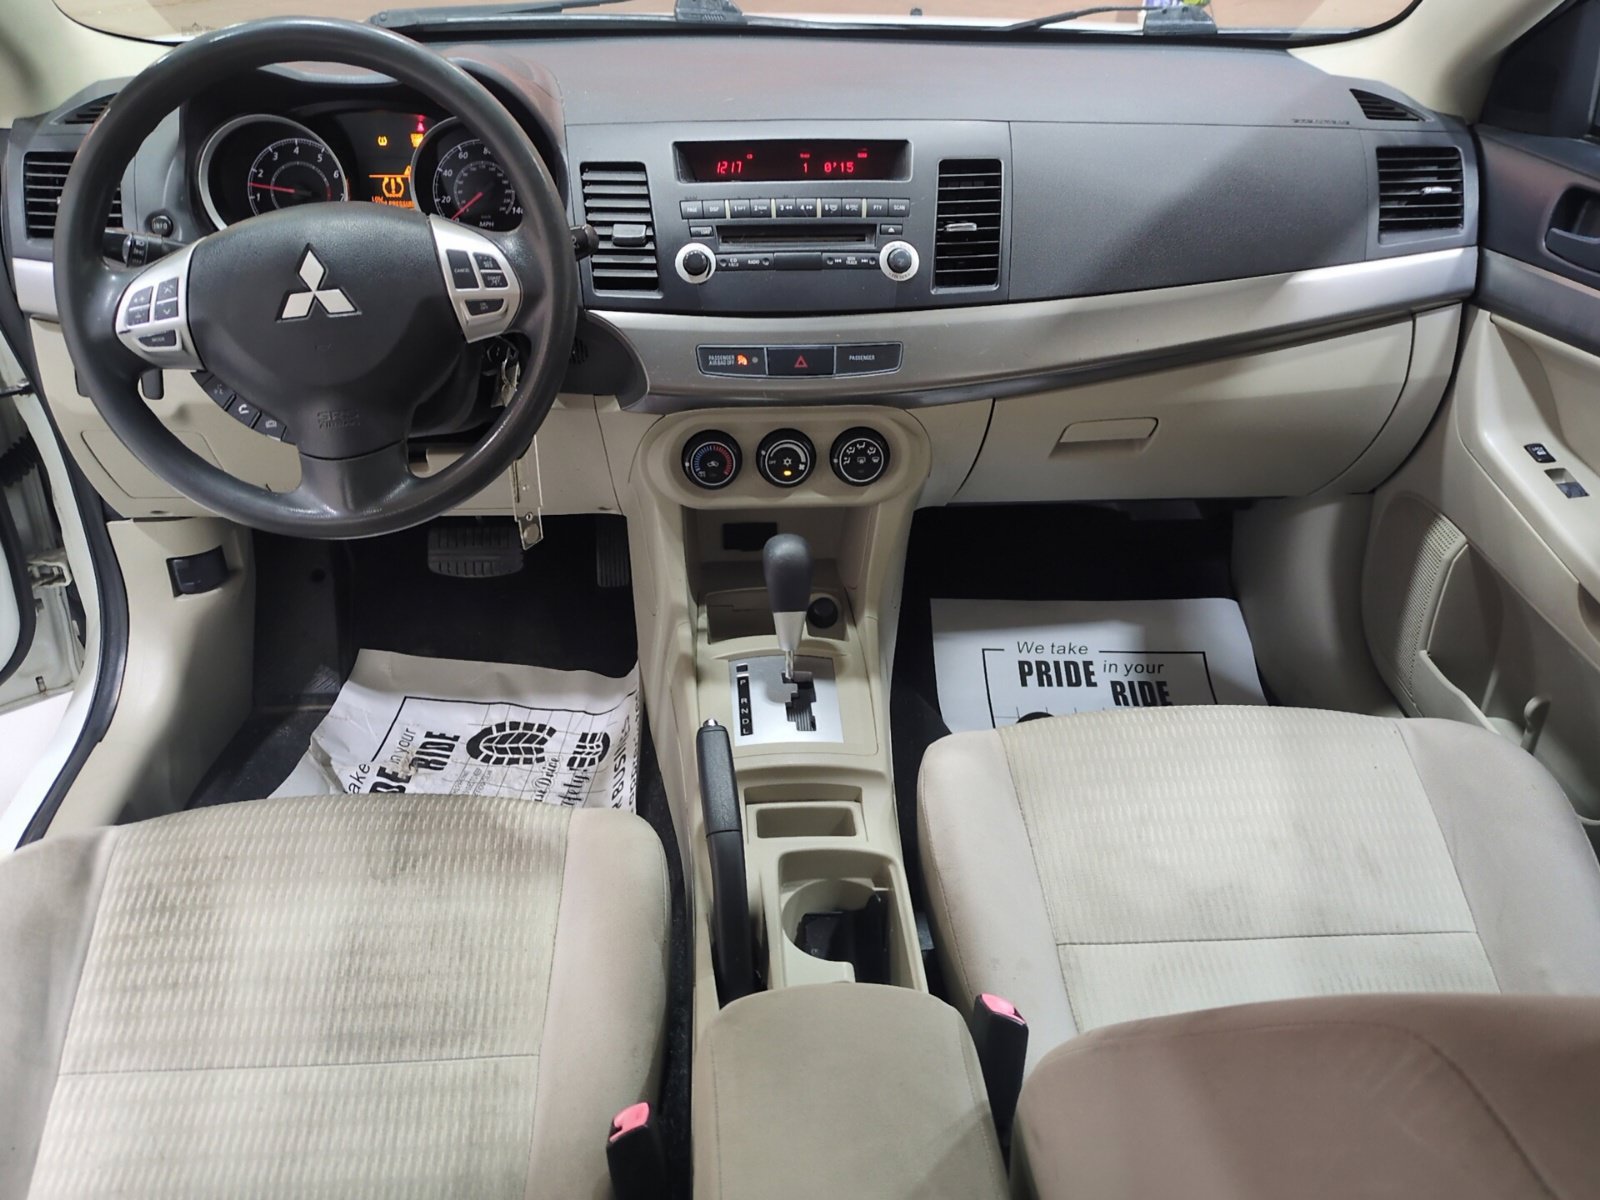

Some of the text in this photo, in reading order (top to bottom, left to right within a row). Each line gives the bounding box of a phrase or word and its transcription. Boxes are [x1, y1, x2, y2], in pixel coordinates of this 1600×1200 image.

[293, 146, 300, 155] 4
[458, 151, 469, 160] 60
[272, 151, 279, 161] 3
[317, 153, 324, 163] 5
[257, 169, 264, 178] 2
[333, 170, 340, 179] 6
[442, 169, 453, 177] 40
[441, 195, 452, 204] 20
[1017, 641, 1088, 655] We take
[1018, 660, 1098, 687] PRIDE
[1103, 660, 1164, 677] in your
[1110, 680, 1174, 707] RIDE
[396, 727, 416, 754] your
[408, 731, 460, 771] RIDE
[345, 762, 371, 794] ake
